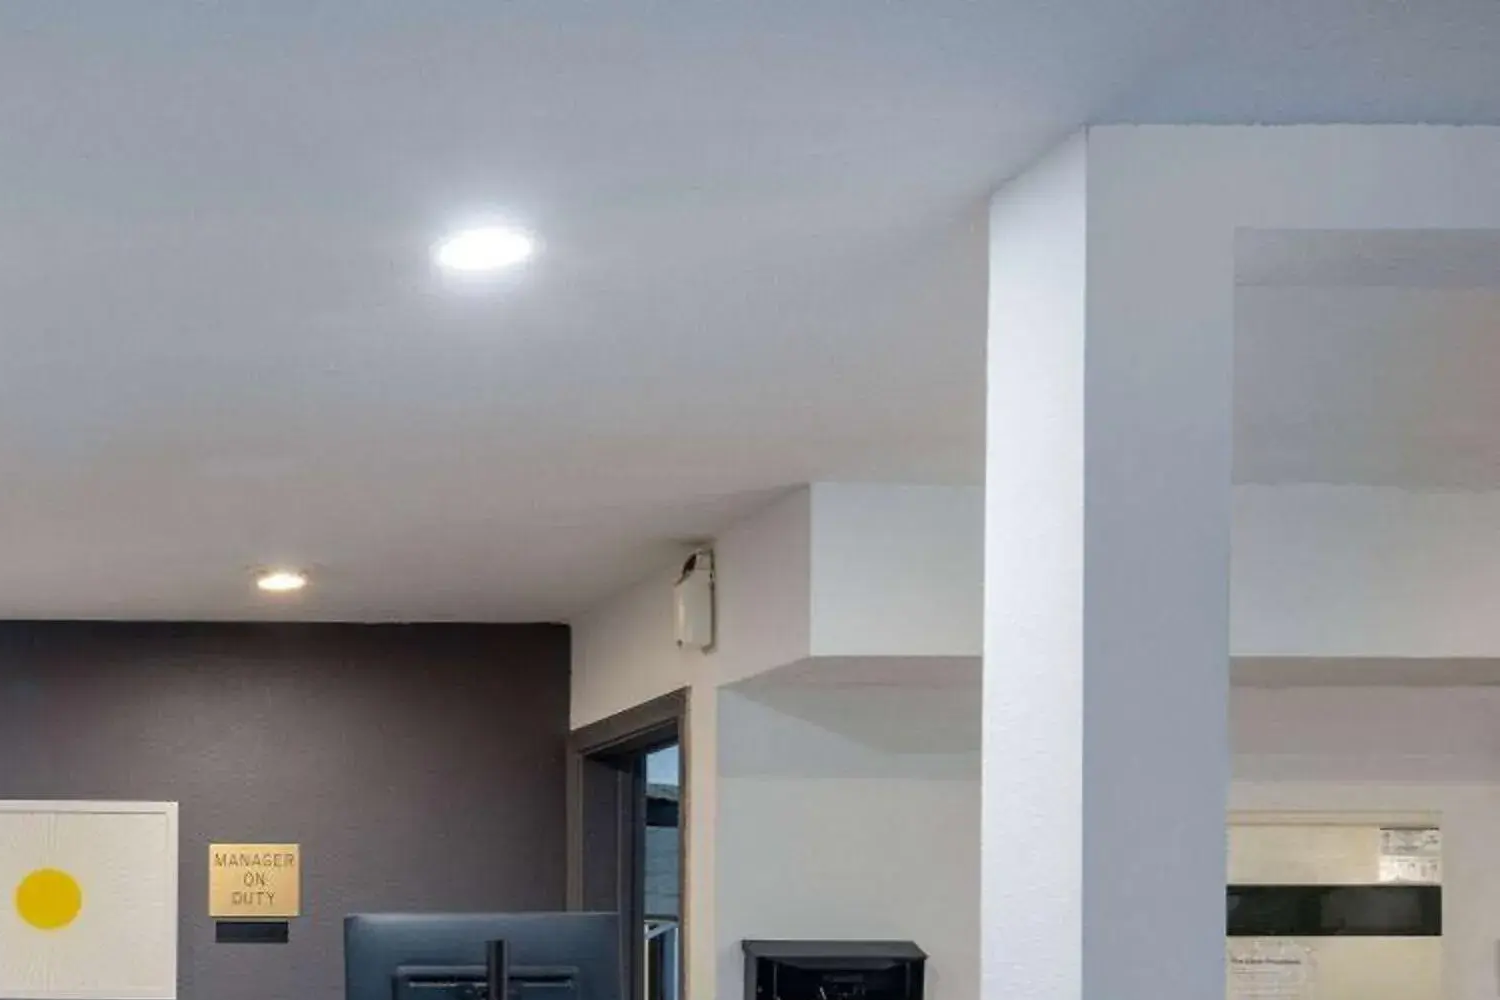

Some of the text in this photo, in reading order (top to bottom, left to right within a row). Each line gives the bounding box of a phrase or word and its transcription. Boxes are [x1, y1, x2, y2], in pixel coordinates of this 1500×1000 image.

[214, 853, 294, 867] MANAGER
[243, 872, 265, 887] ON
[231, 891, 275, 905] DUTY
